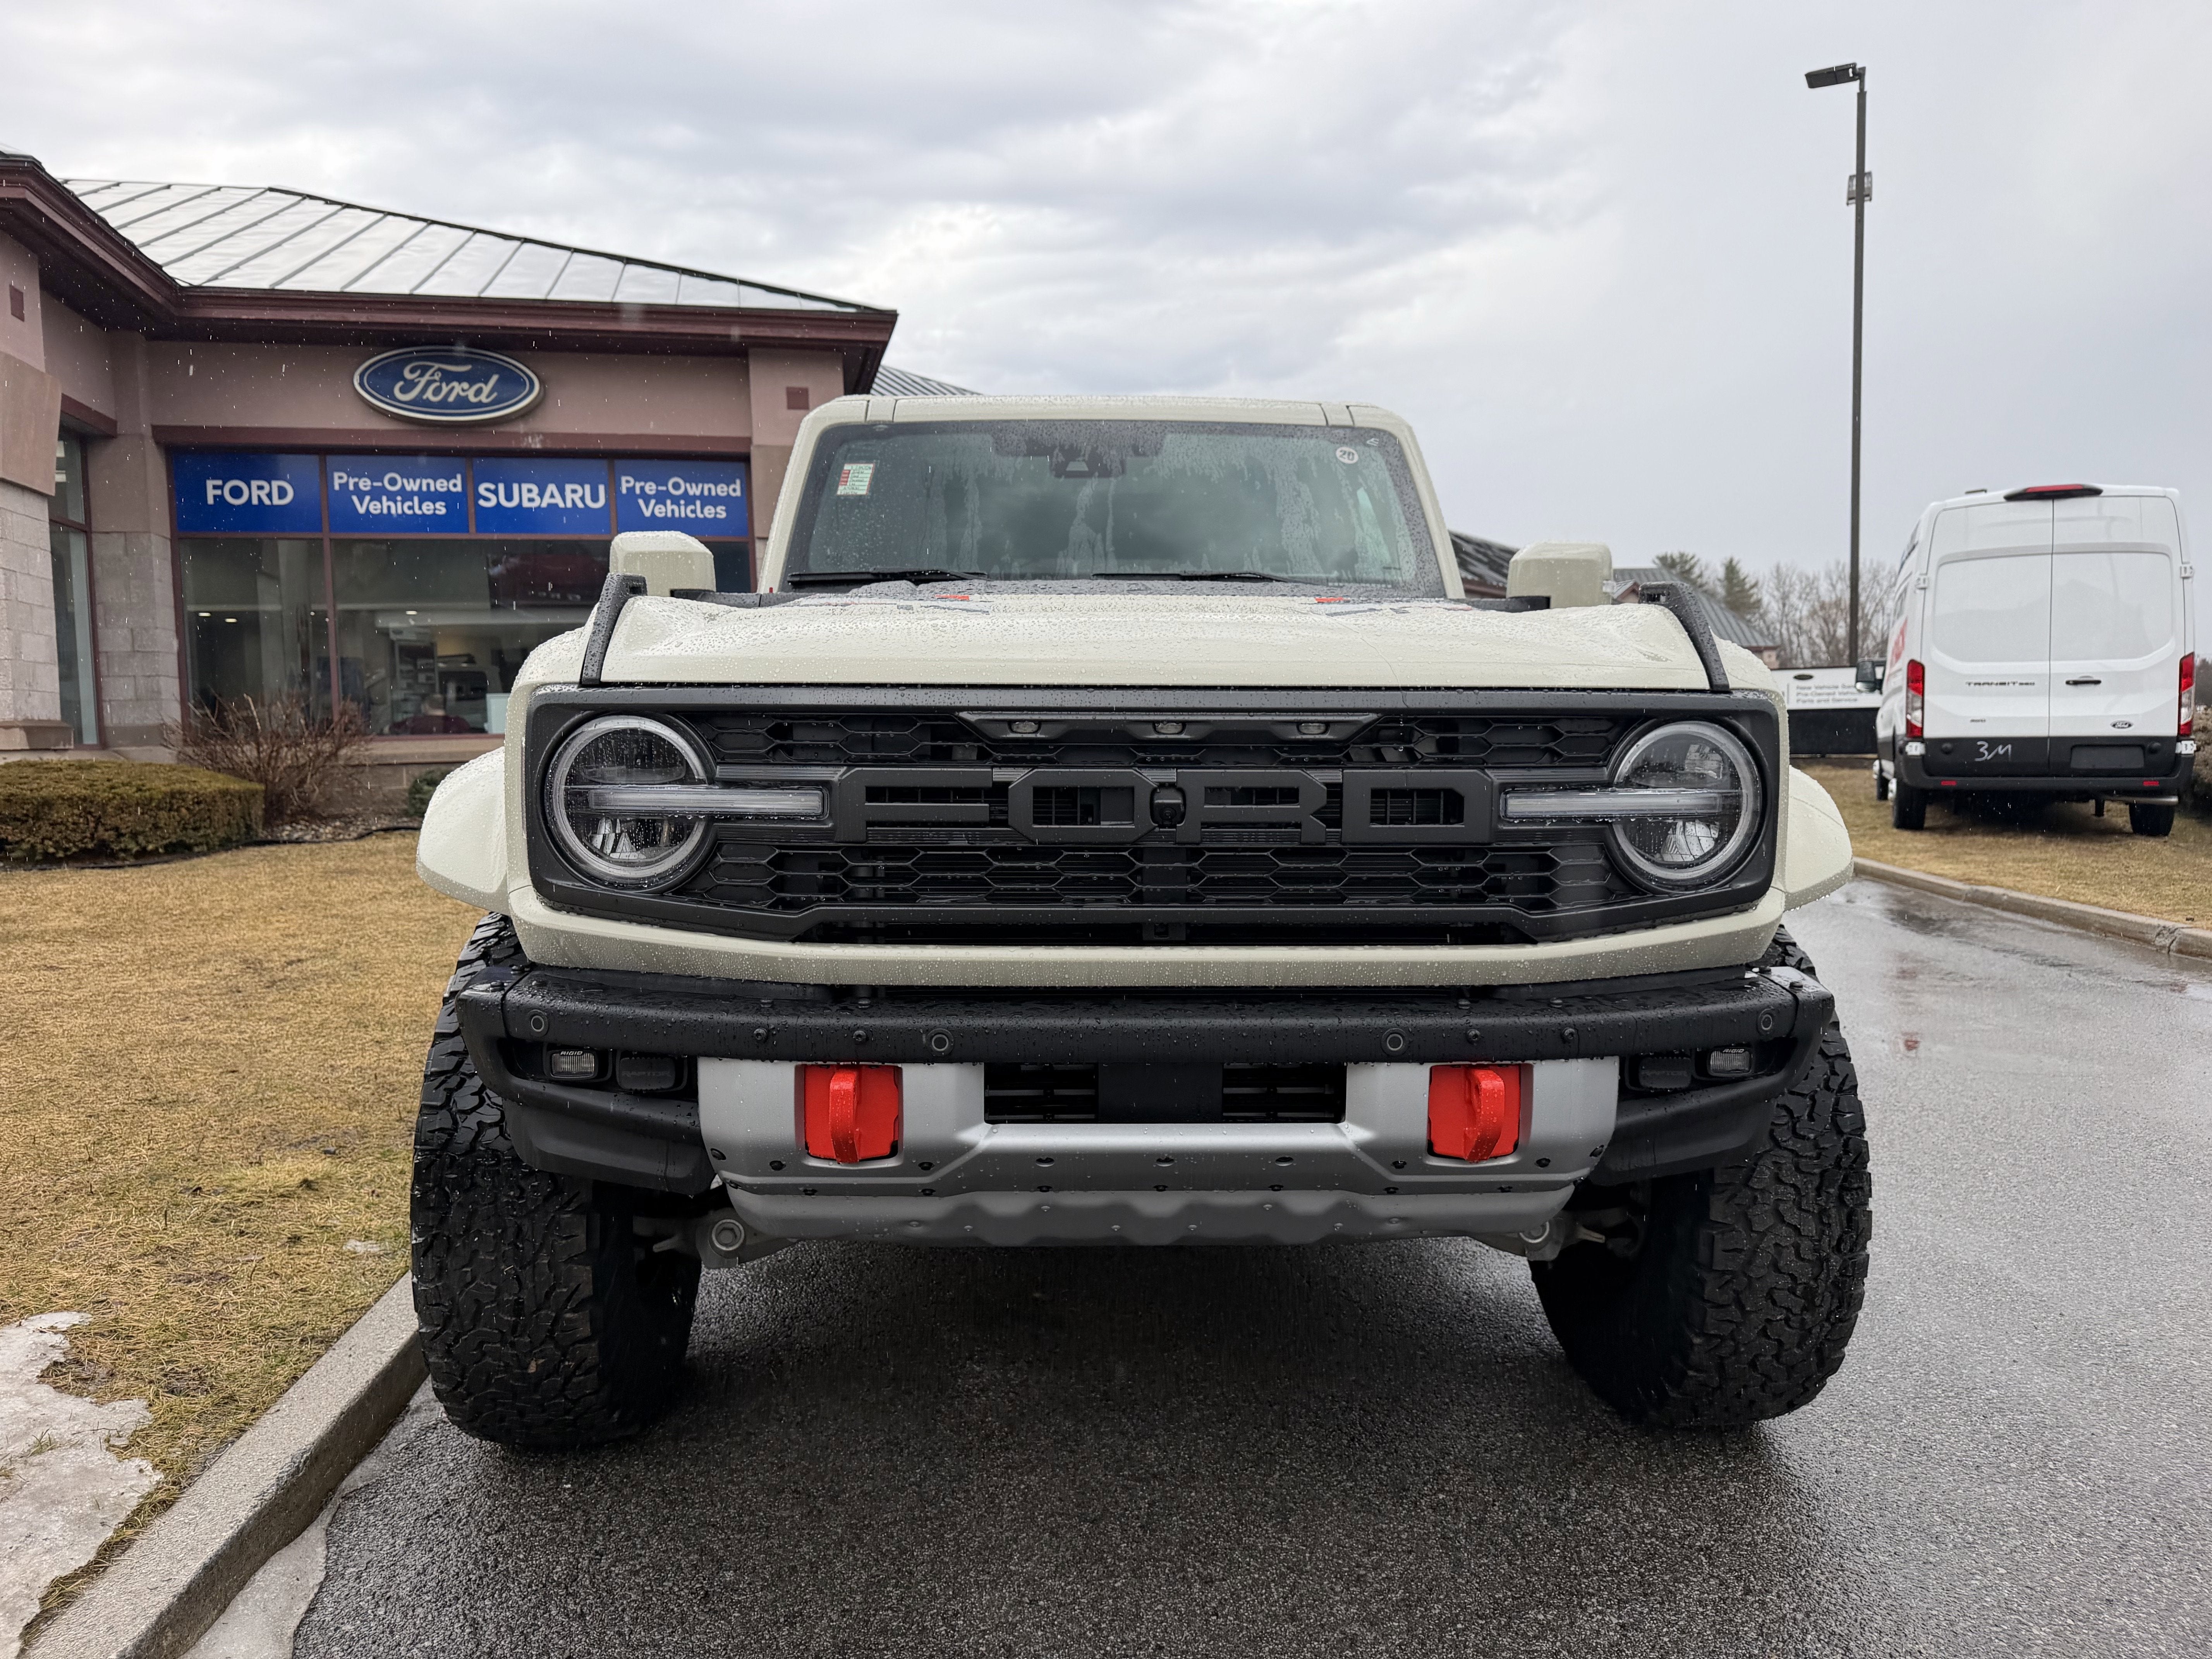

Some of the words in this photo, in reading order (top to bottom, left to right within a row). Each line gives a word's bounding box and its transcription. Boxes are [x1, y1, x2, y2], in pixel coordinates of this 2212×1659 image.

[393, 361, 500, 404] Ford
[206, 479, 295, 506] FORD
[333, 471, 462, 492] Pre-Owned
[620, 475, 742, 497] Pre-Owned
[351, 495, 447, 515] Vehicles
[477, 482, 606, 508] SUBARU
[637, 498, 727, 519] Vehicles
[835, 767, 1493, 845] FORD
